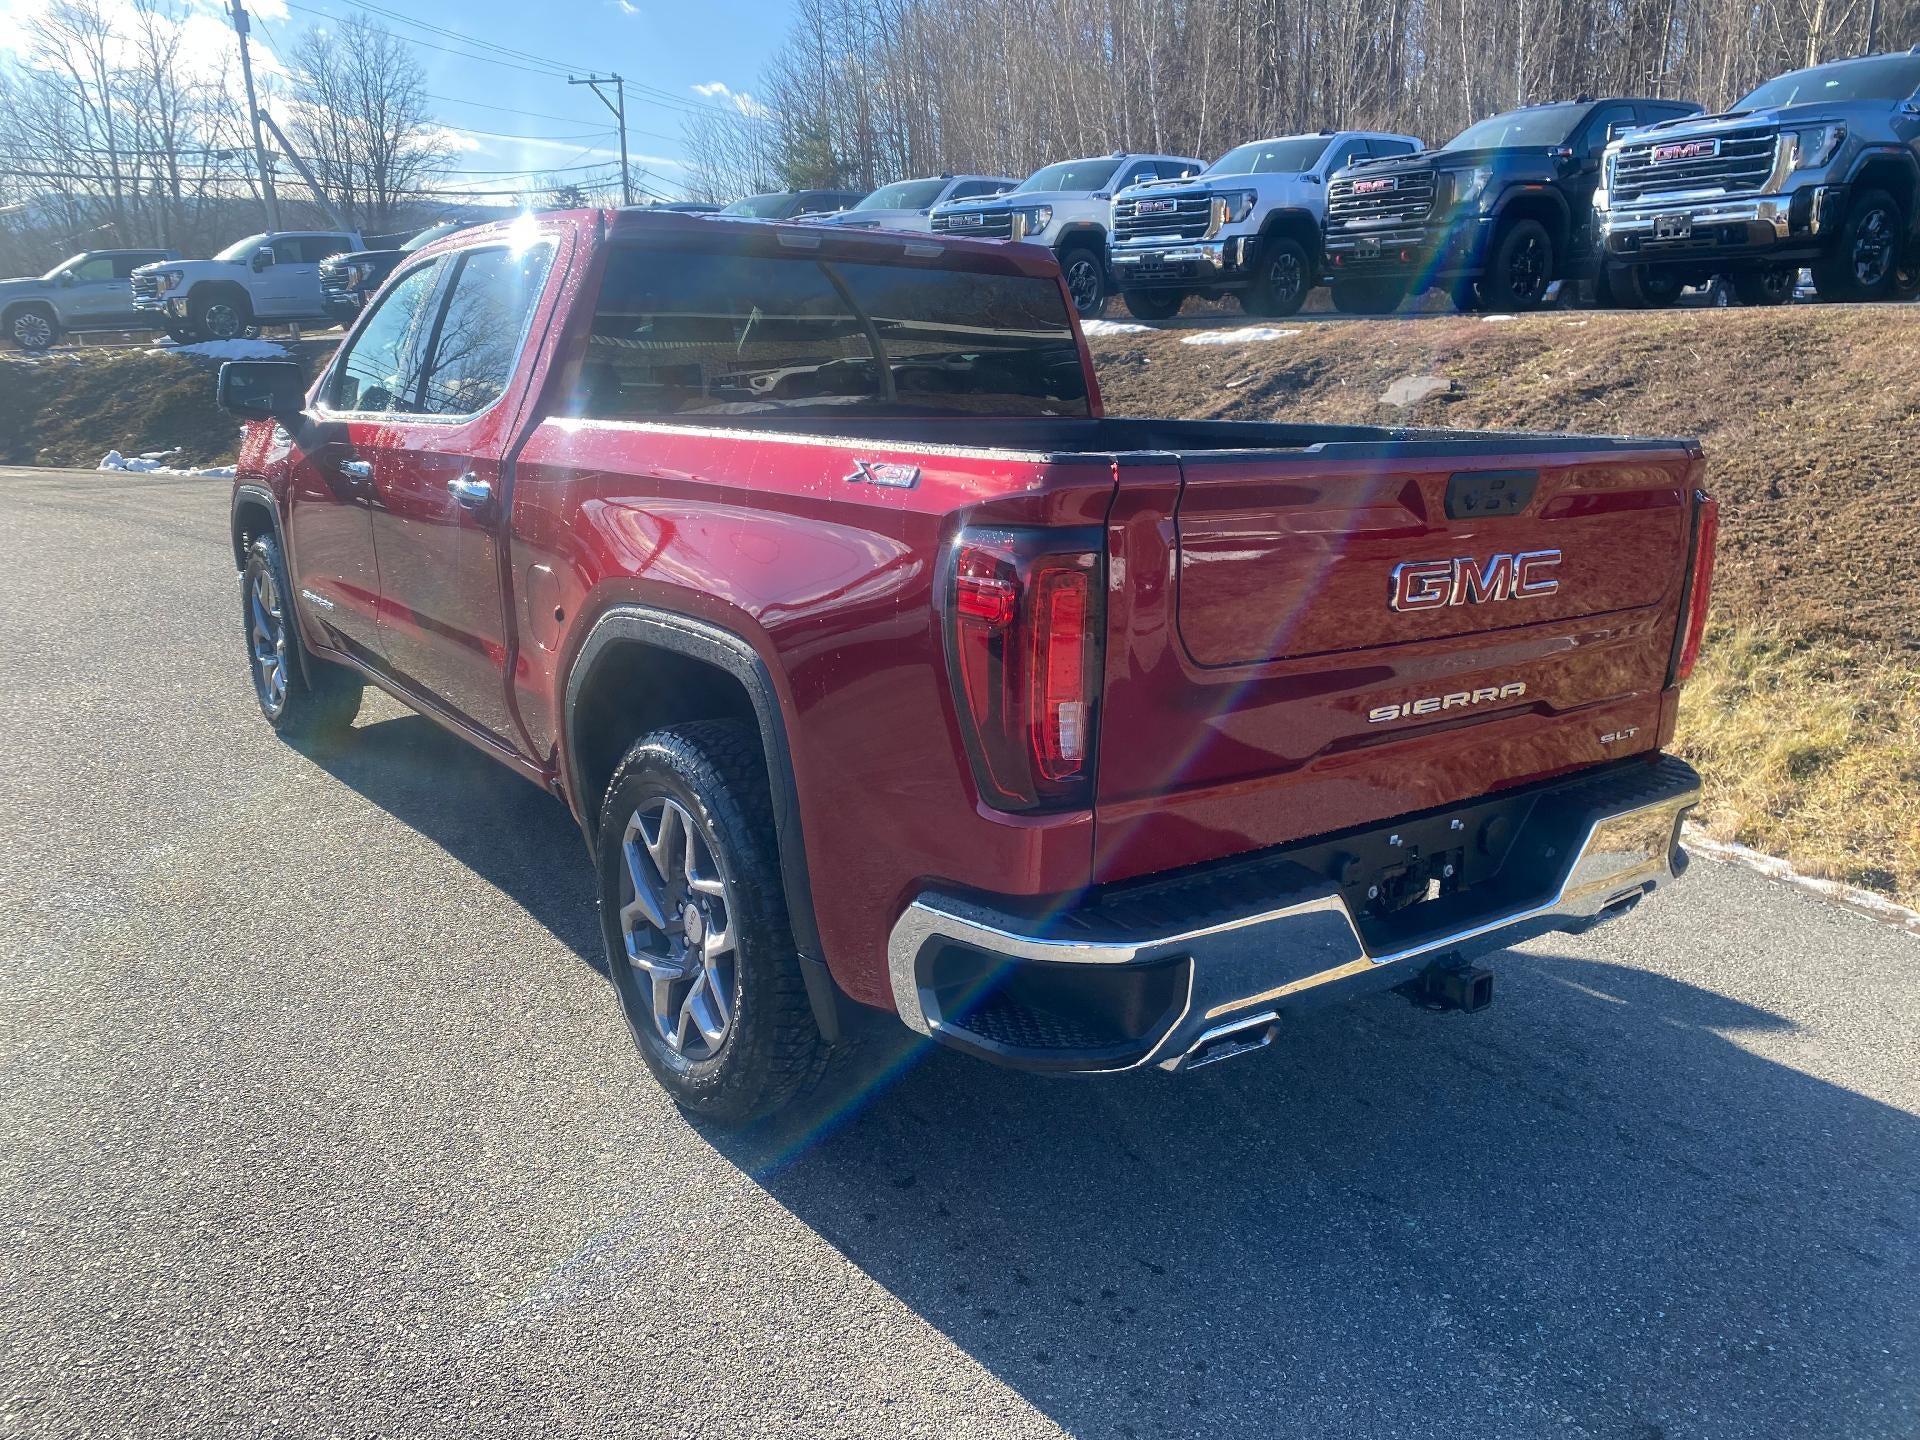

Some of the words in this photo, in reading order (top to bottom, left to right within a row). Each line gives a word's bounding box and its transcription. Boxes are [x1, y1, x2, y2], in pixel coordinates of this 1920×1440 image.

[1655, 141, 1714, 160] GMC
[1390, 550, 1562, 612] GMC
[1368, 681, 1526, 723] SIERRA
[1600, 727, 1640, 744] SLT
